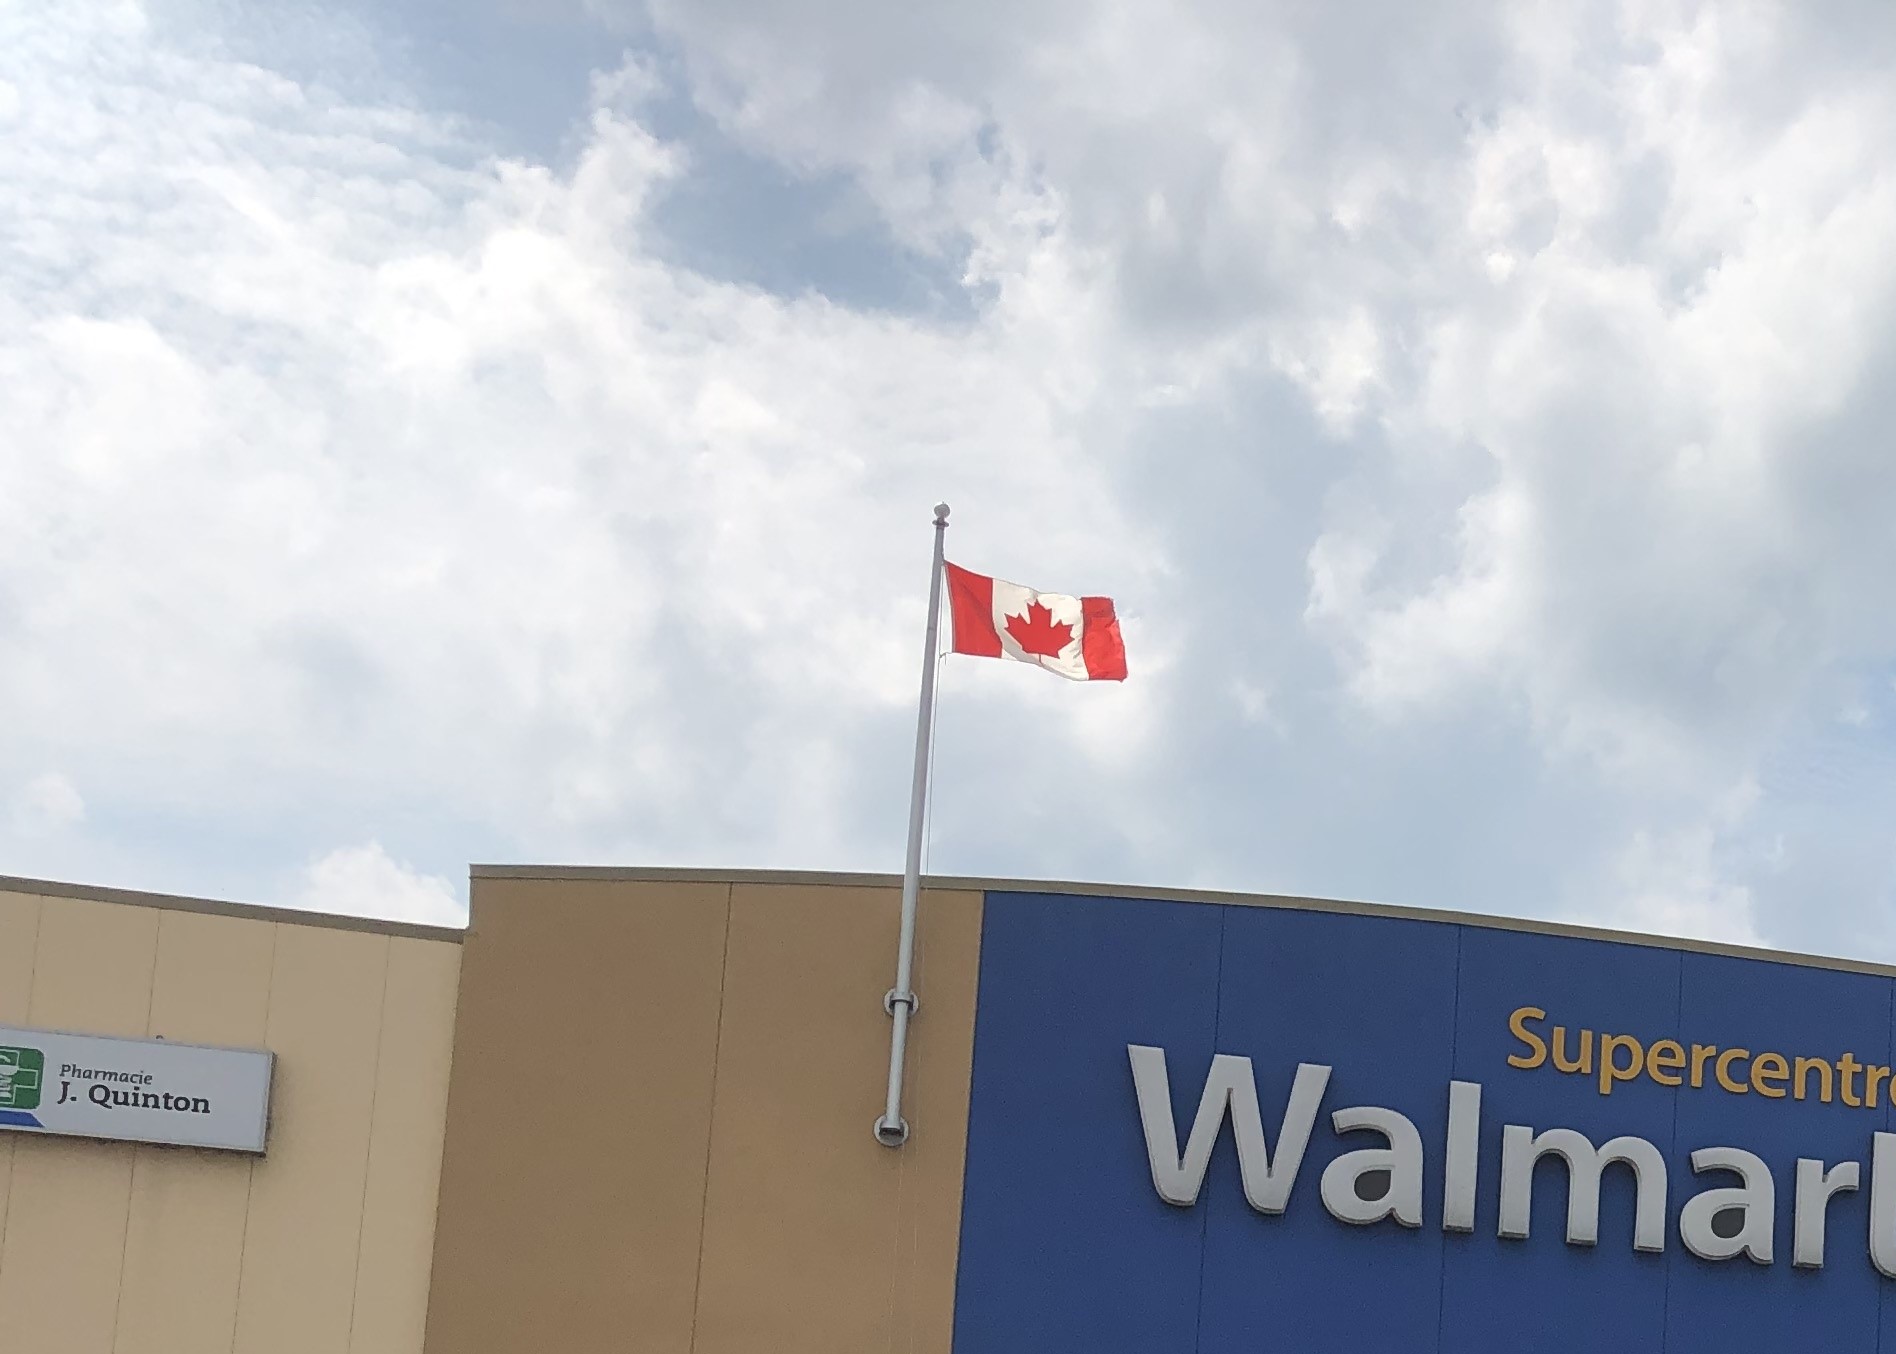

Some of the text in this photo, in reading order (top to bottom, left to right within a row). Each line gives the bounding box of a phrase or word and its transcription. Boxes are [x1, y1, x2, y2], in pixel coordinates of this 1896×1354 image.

[59, 1063, 153, 1086] Pharmacie
[57, 1081, 211, 1115] J. Quinton
